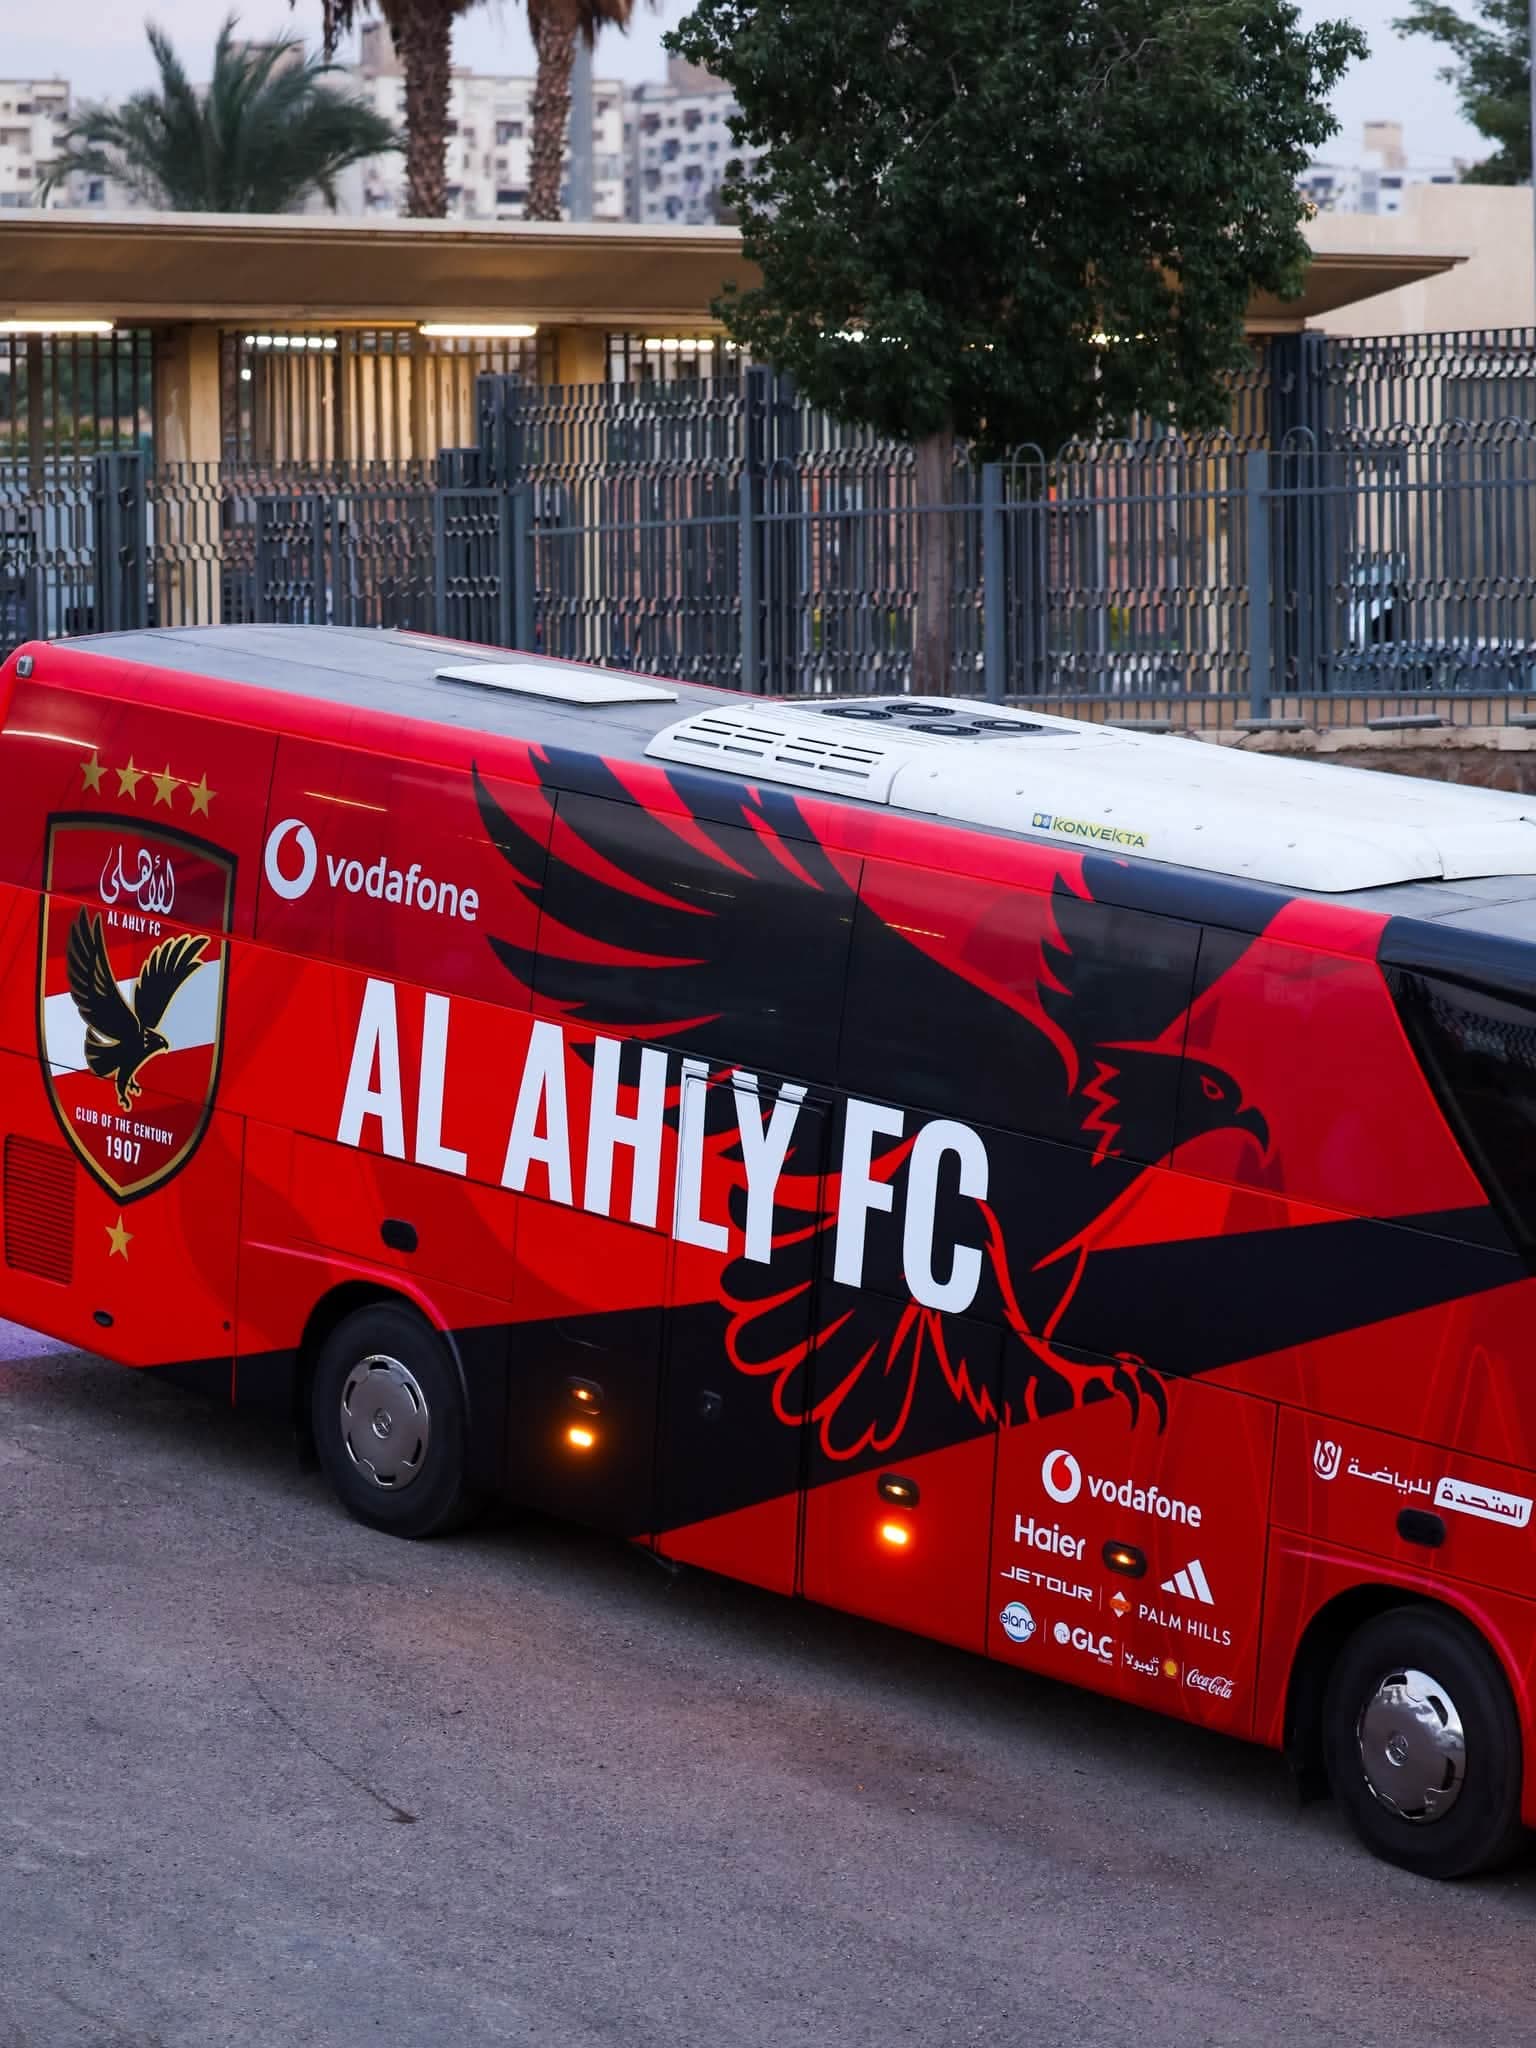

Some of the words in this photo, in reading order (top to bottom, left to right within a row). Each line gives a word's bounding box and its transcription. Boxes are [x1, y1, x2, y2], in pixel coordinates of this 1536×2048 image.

[1052, 816, 1146, 848] KONVEKTA
[326, 853, 480, 922] vodafone
[107, 910, 119, 927] AL
[122, 913, 146, 933] AHLY
[149, 919, 161, 937] FC
[75, 1106, 98, 1125] CLUB
[101, 1113, 112, 1128] OF
[115, 1117, 131, 1134] THE
[134, 1122, 174, 1146] CENTURY
[105, 1135, 141, 1165] 1907
[336, 977, 468, 1177] AL
[500, 1019, 809, 1265] AHLY
[832, 1097, 990, 1315] FC
[1347, 1457, 1432, 1496] للرياضة
[1087, 1475, 1202, 1528] vodafone
[1441, 1482, 1524, 1521] المتحدة
[1014, 1514, 1086, 1561] Haier
[1000, 1565, 1093, 1602] JETOUR
[1000, 1611, 1036, 1632] elano
[1139, 1603, 1182, 1632] PALM
[1187, 1618, 1232, 1646] HILLS
[1071, 1626, 1113, 1659] GLC
